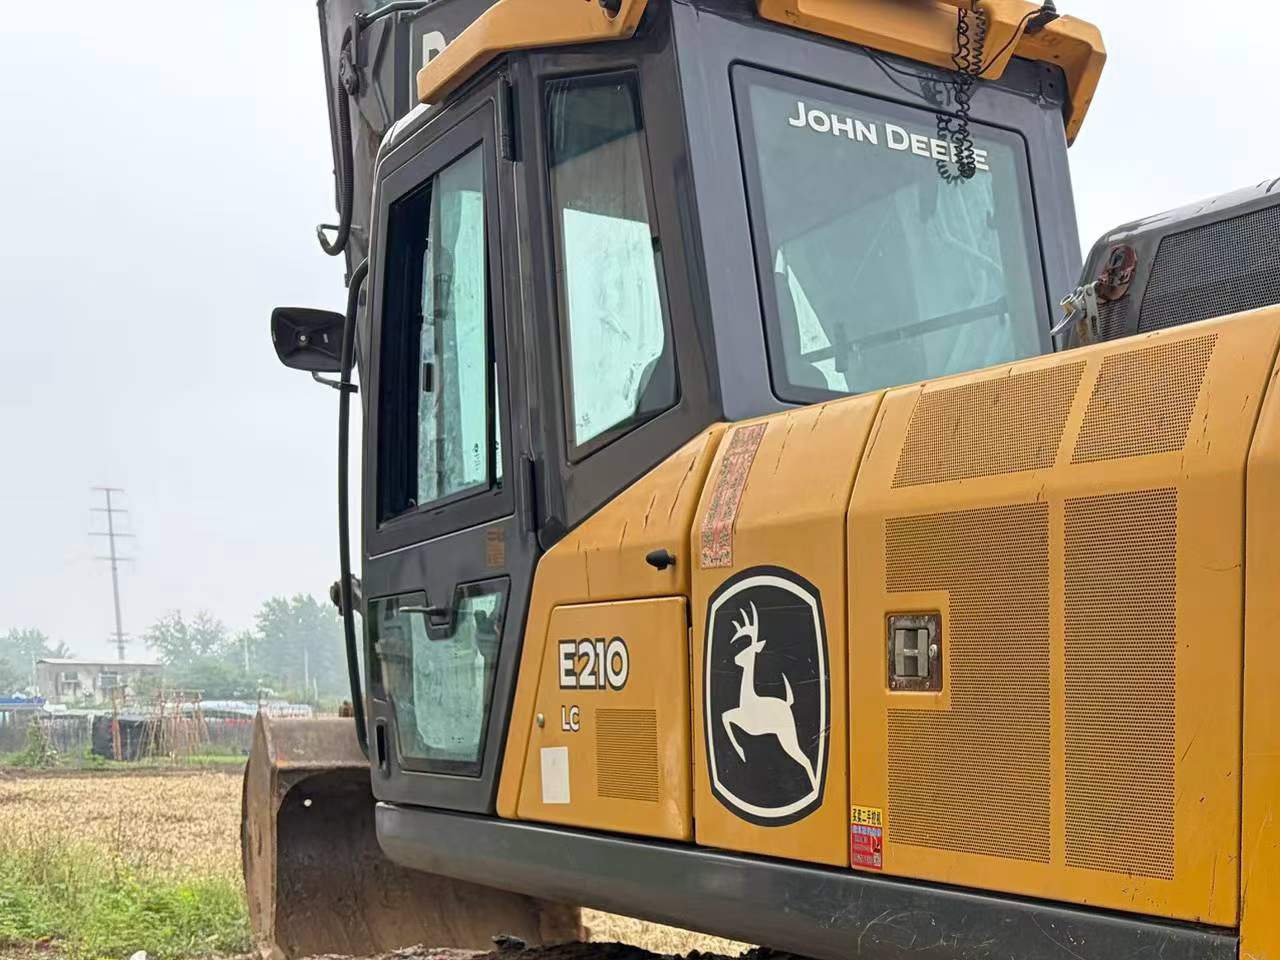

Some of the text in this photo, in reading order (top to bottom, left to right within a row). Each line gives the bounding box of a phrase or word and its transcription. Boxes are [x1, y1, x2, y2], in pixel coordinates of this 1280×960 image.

[788, 101, 879, 146] JOHN
[558, 637, 630, 691] E210
[561, 705, 580, 733] LC
